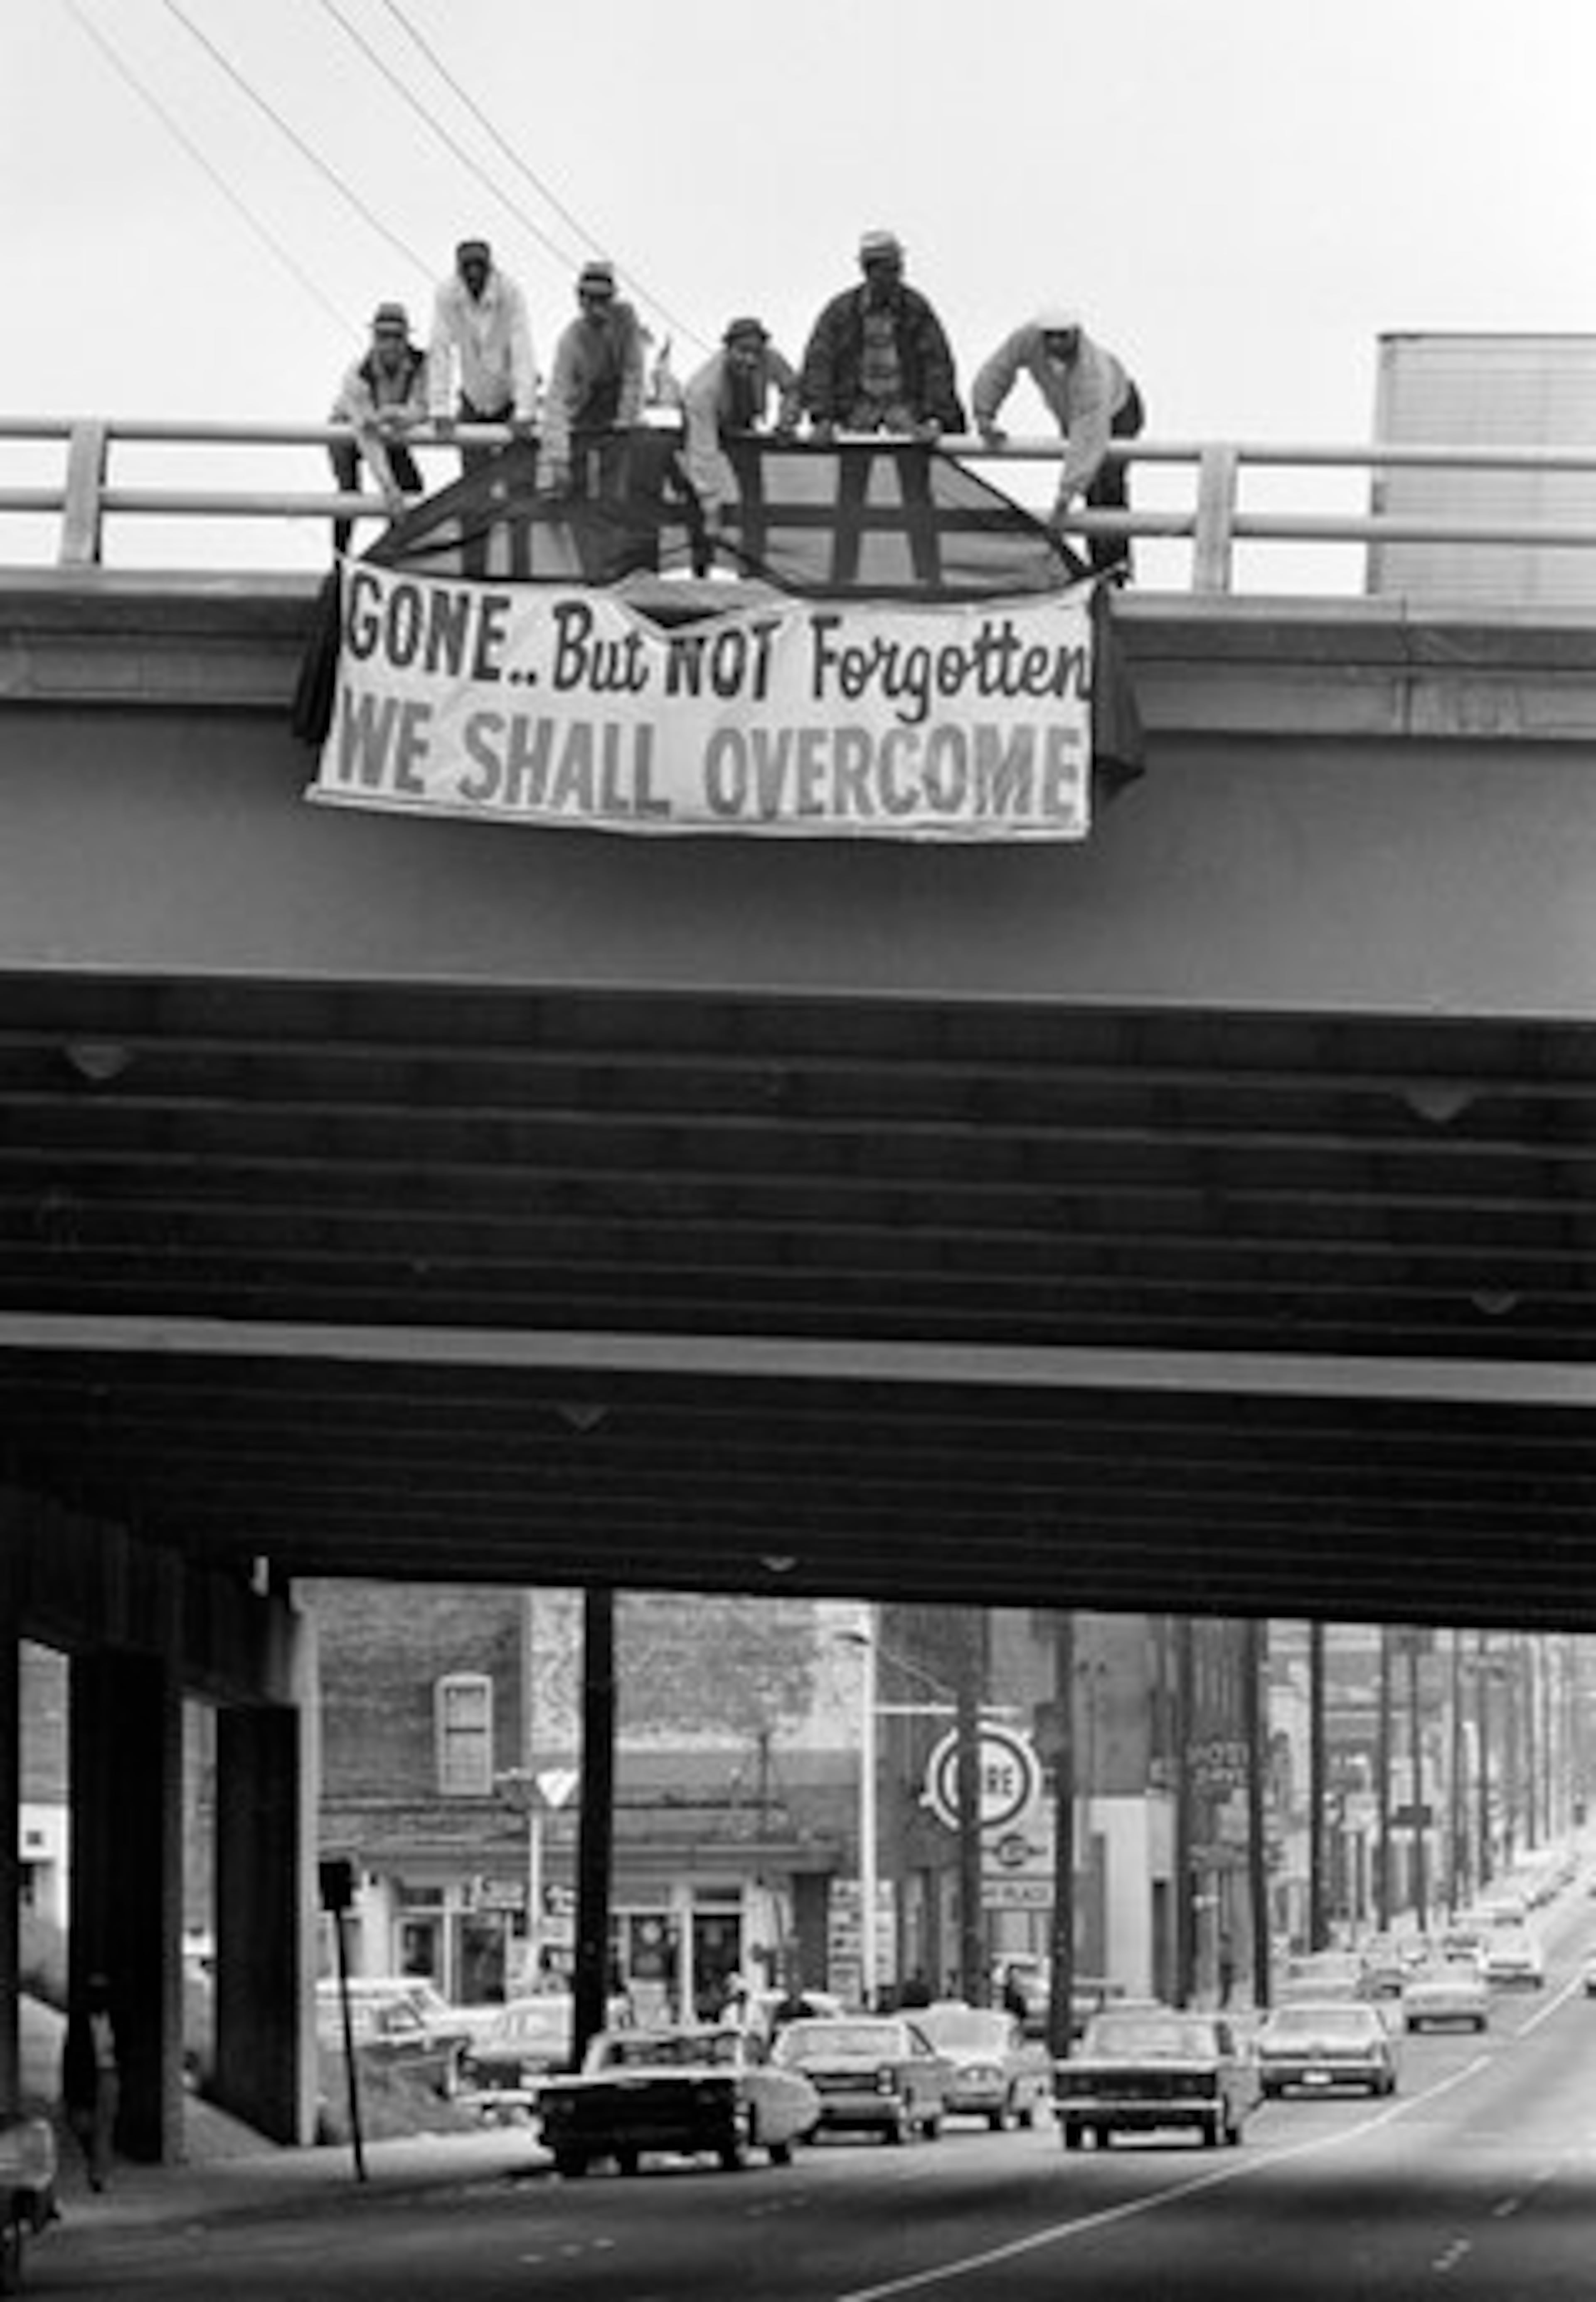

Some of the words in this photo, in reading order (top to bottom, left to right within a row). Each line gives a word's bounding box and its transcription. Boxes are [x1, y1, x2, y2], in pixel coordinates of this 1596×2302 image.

[553, 600, 649, 692] But
[665, 620, 781, 700] NOT
[810, 615, 1090, 722] Forgotten
[337, 687, 432, 793] WE
[456, 712, 671, 816] SHALL
[705, 723, 1081, 819] OVERCOME
